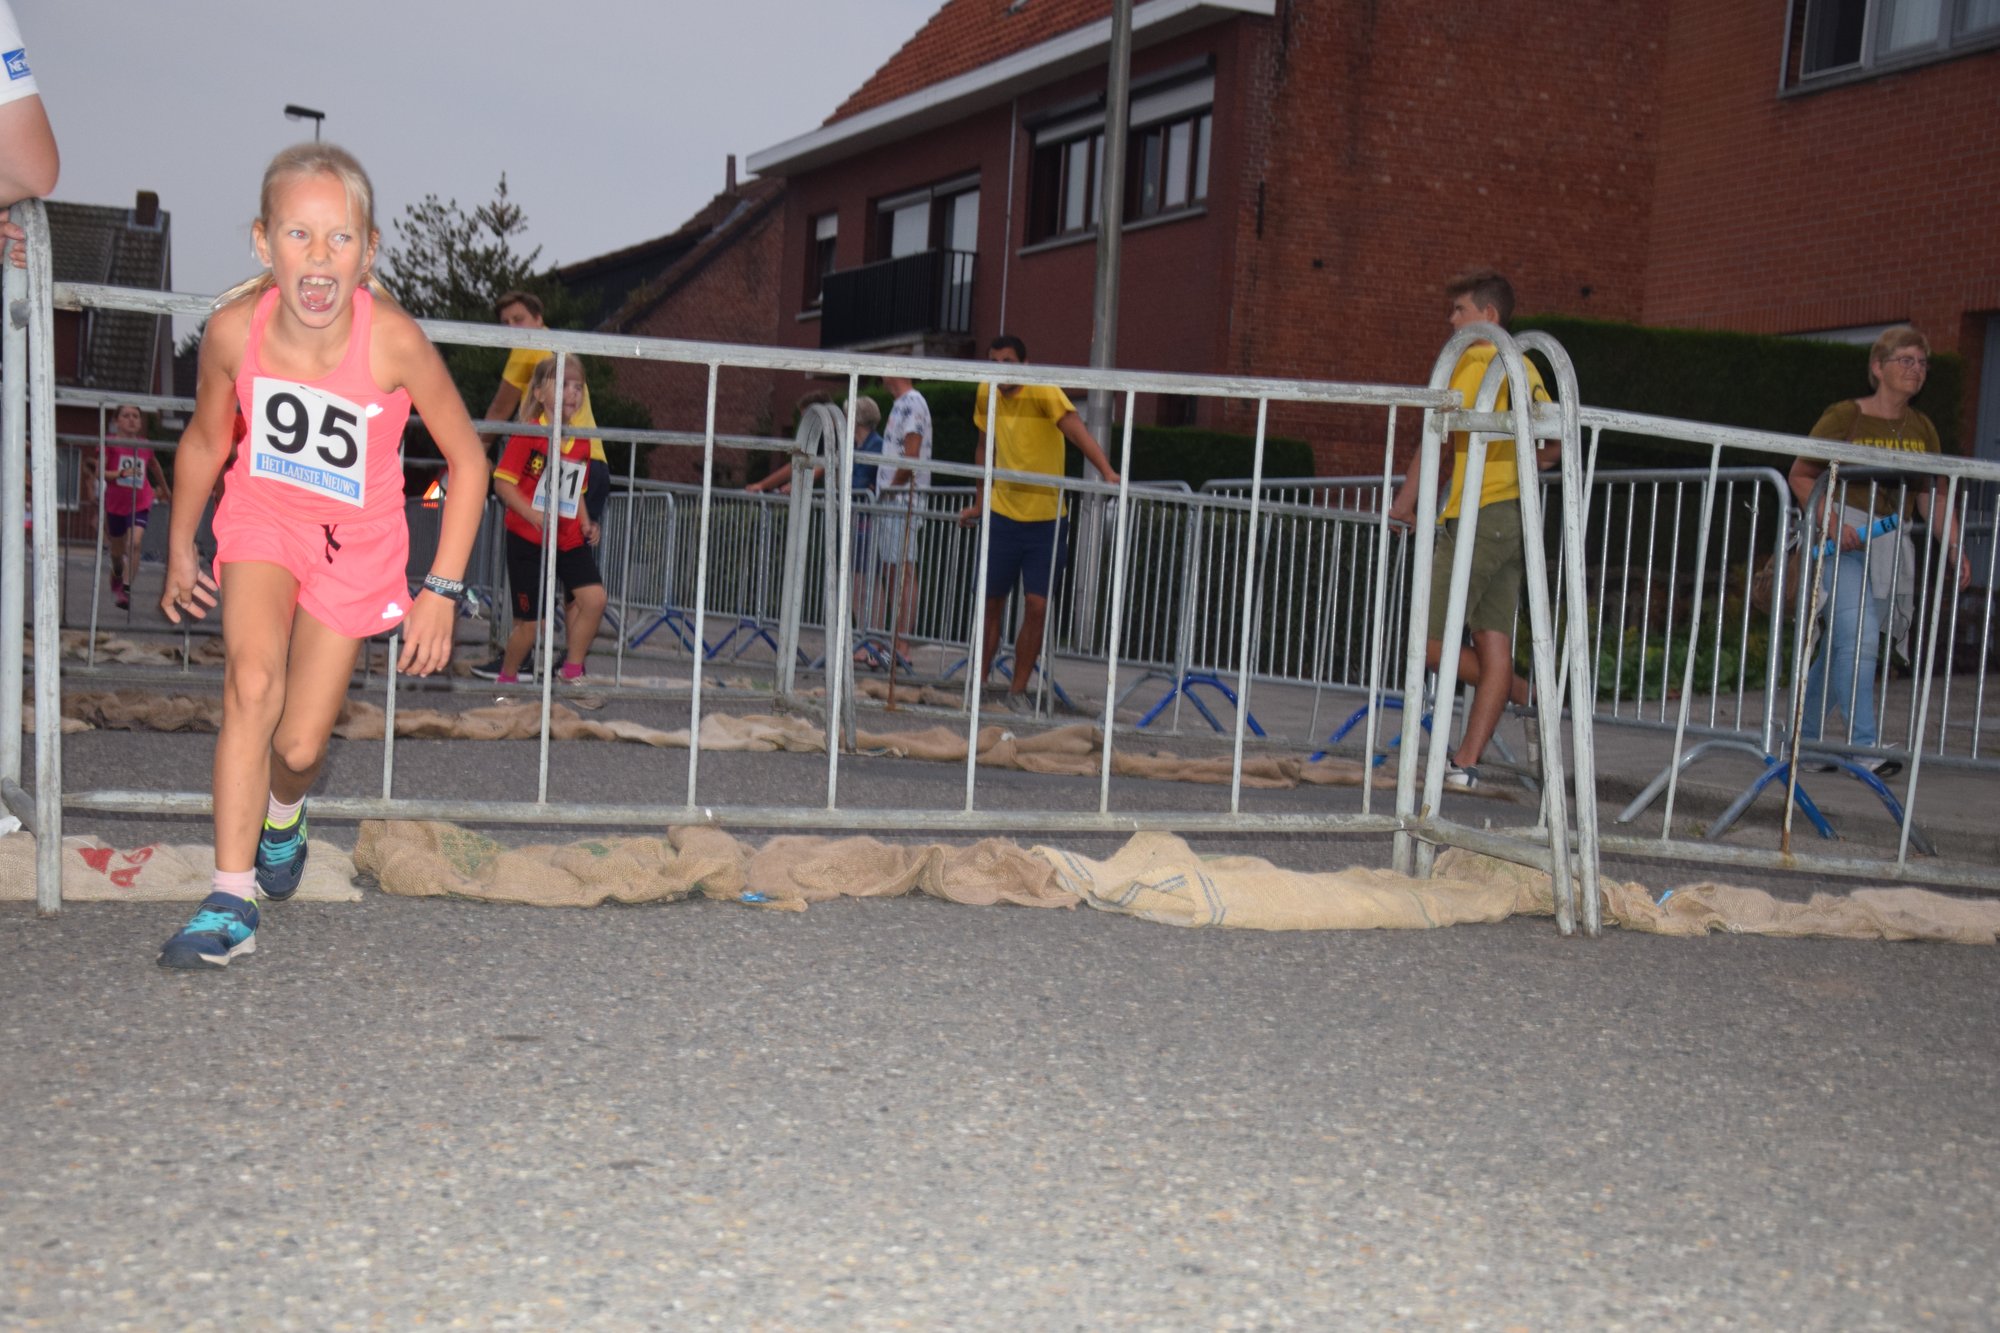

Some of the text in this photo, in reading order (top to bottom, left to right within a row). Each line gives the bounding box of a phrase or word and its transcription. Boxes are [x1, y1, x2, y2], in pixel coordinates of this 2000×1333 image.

[265, 392, 358, 469] 95
[261, 455, 356, 497] HET LAATSTE NIEUWS
